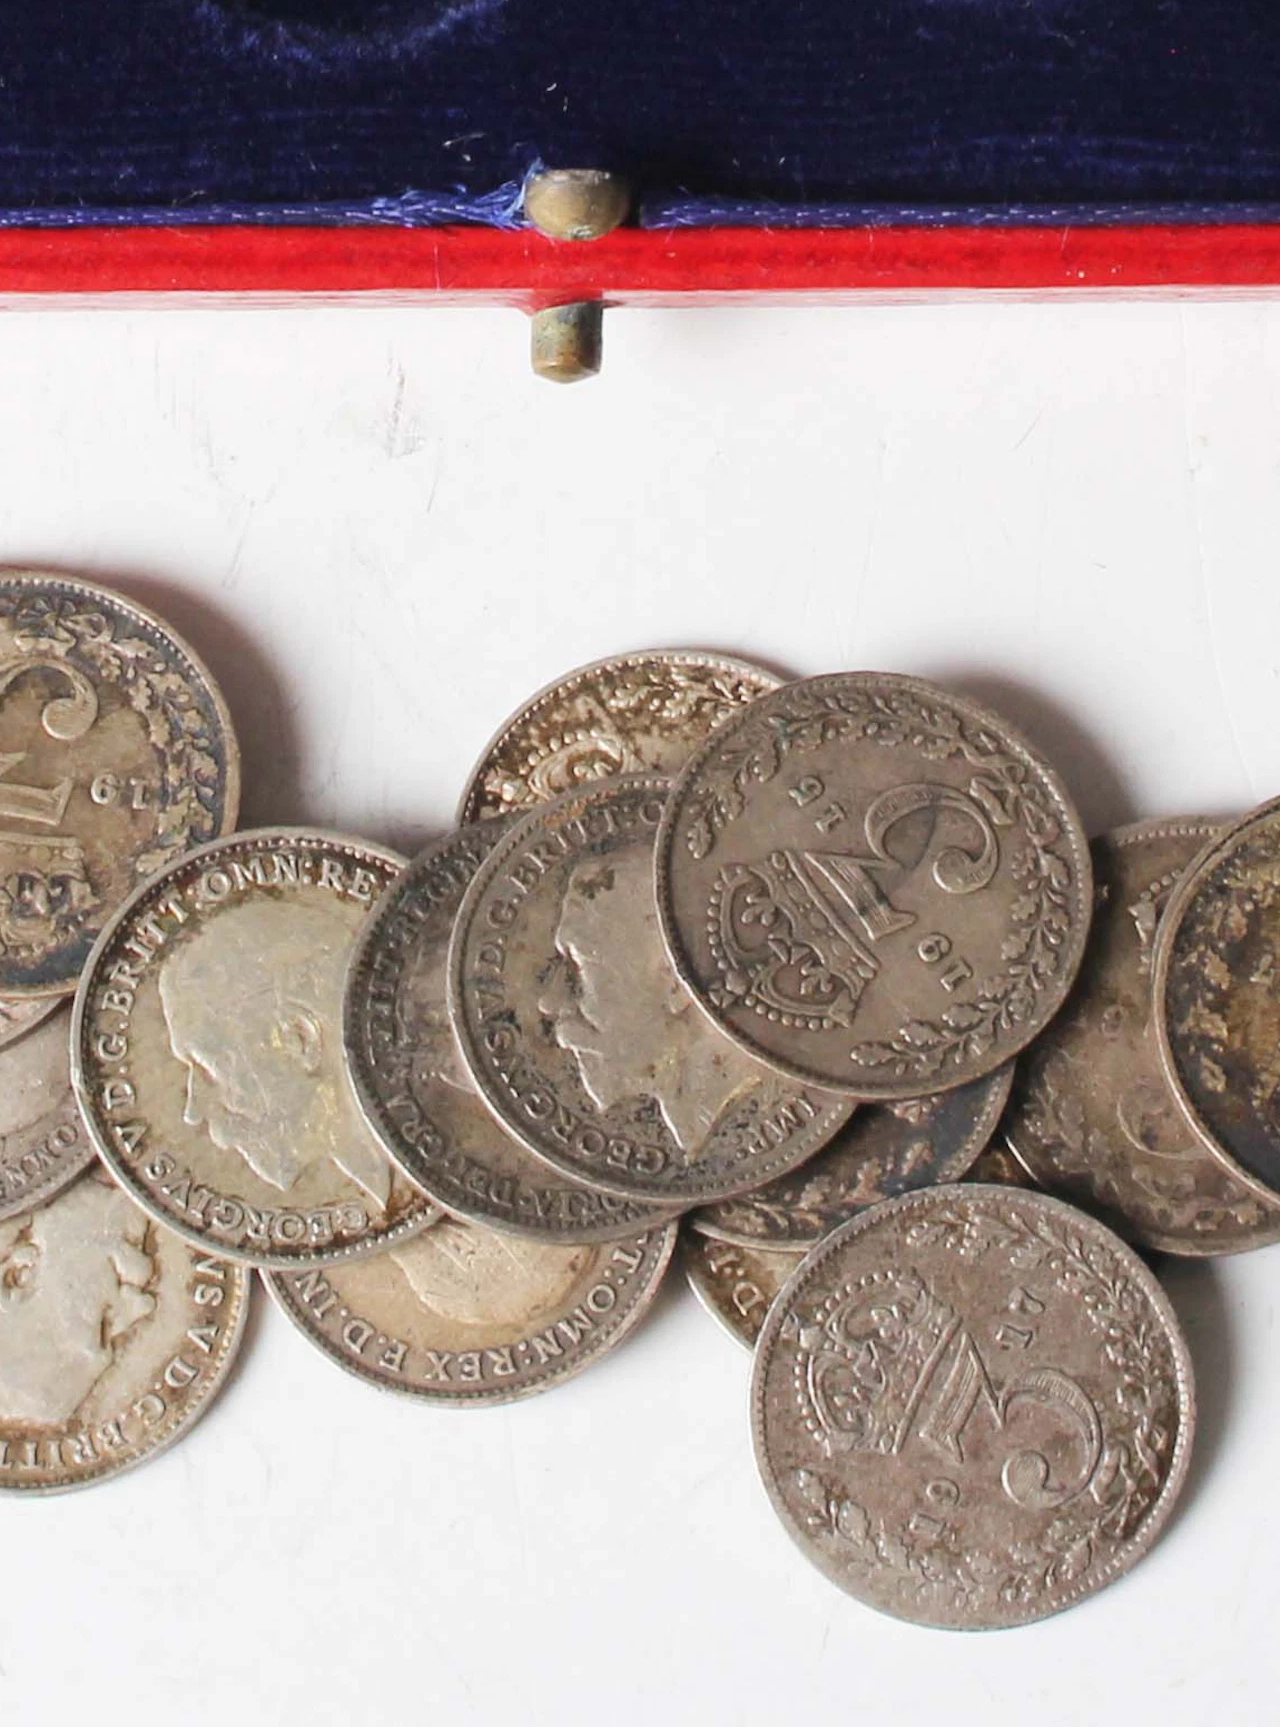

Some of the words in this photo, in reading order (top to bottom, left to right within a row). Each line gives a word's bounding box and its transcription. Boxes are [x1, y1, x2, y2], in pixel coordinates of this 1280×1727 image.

[90, 775, 152, 810] 19
[794, 775, 848, 834] 15
[916, 929, 973, 993] 19
[112, 1110, 154, 1155] V
[139, 1150, 372, 1243] GEORGIVS
[177, 1317, 218, 1361] V
